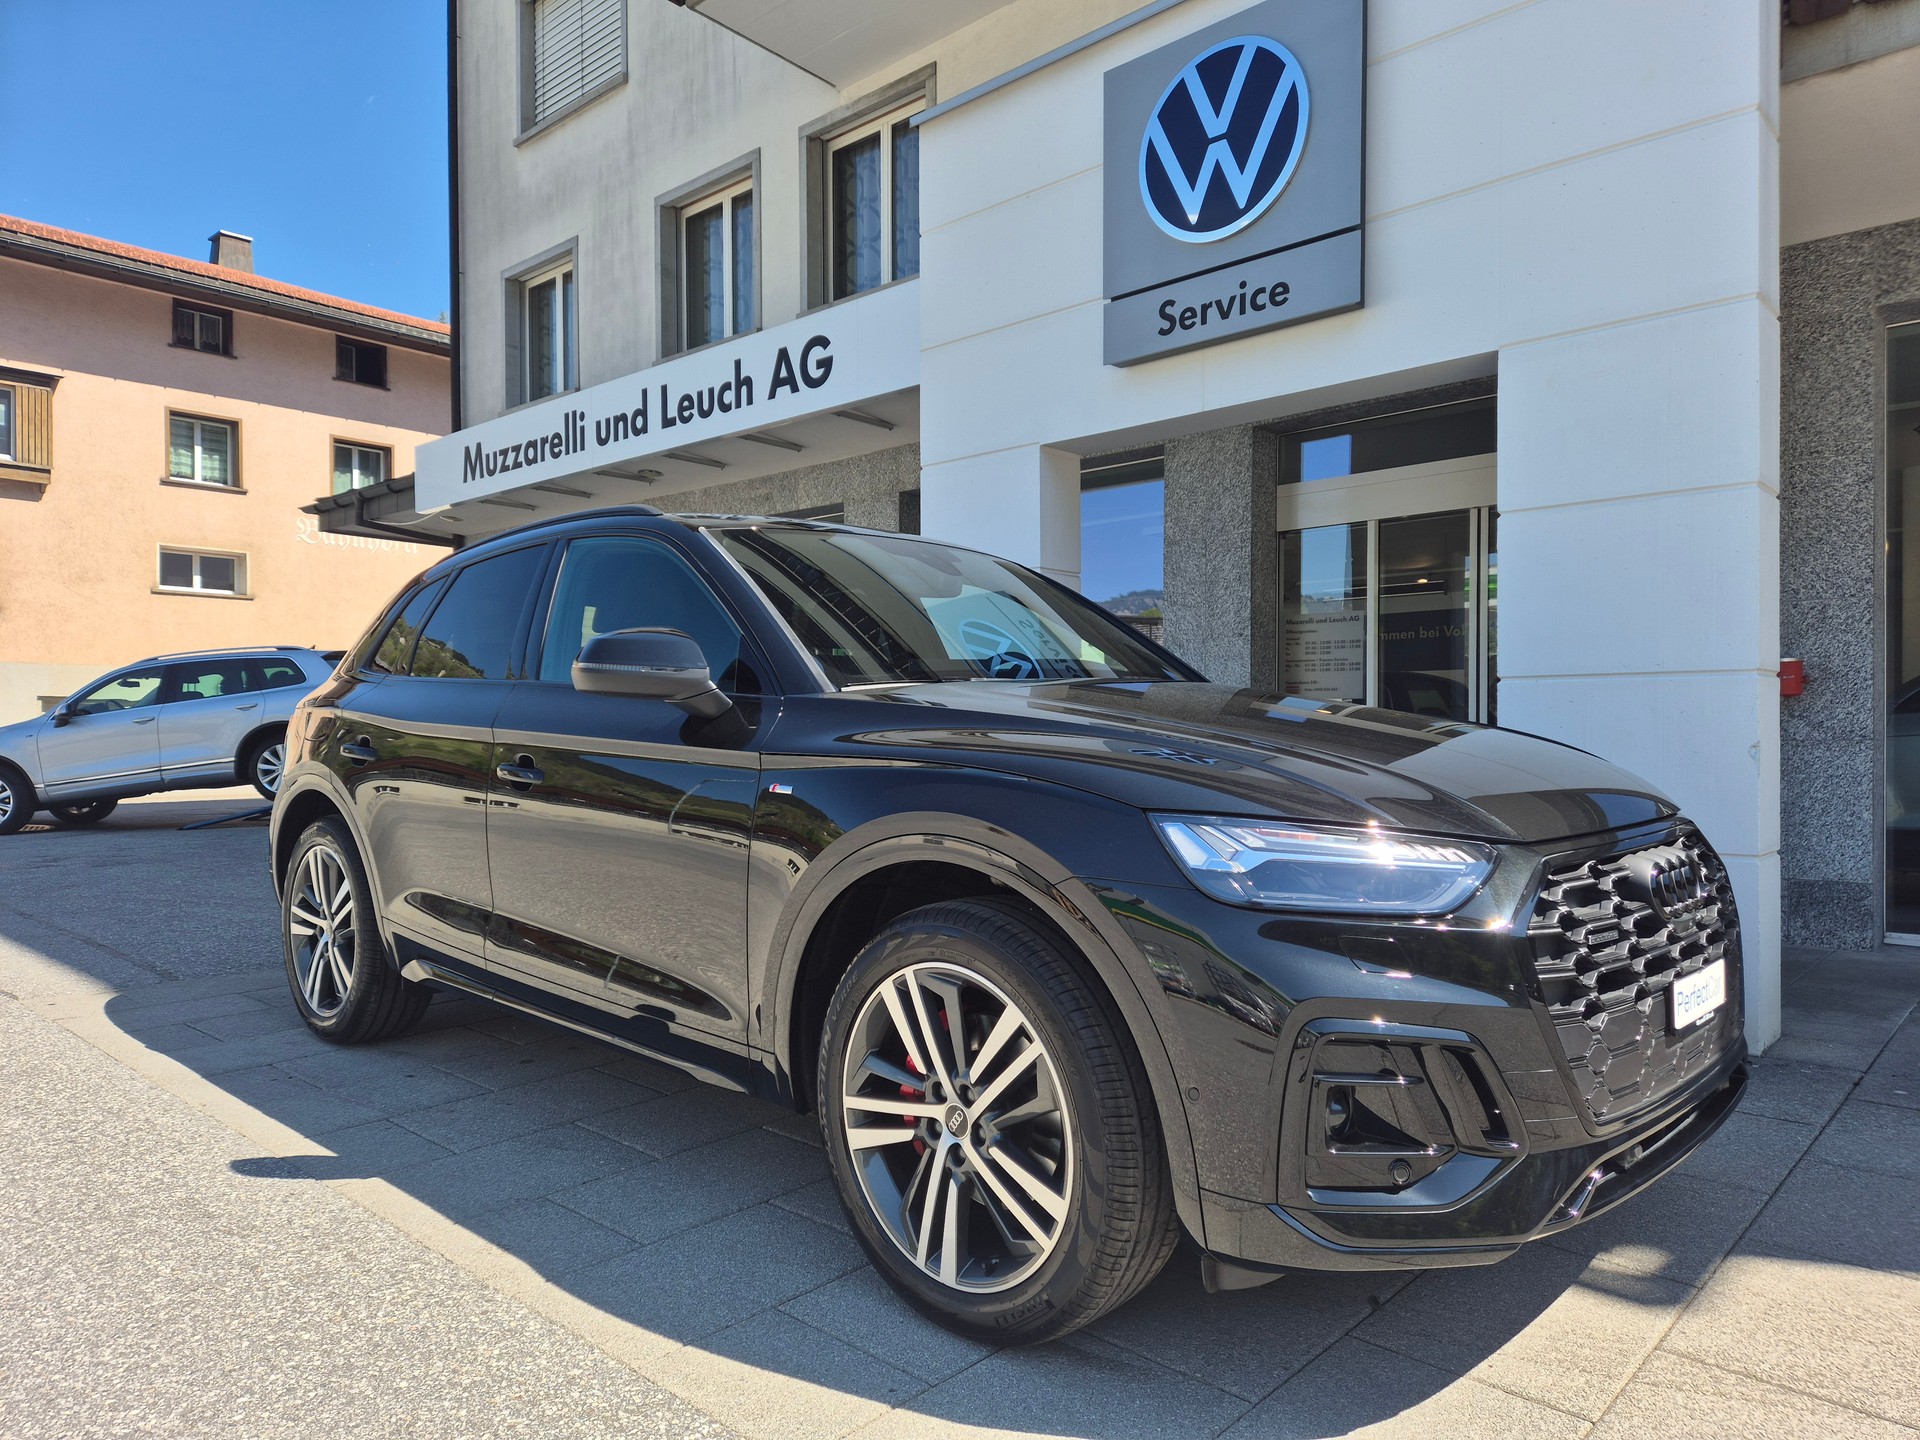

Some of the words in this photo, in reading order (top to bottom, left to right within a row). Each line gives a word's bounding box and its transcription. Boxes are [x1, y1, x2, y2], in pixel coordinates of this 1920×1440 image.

[1157, 280, 1290, 337] Service
[462, 409, 586, 484] Muzzarelli
[595, 387, 649, 447] und
[660, 358, 754, 430] Leuch
[767, 334, 834, 401] AG
[1420, 626, 1439, 638] bei
